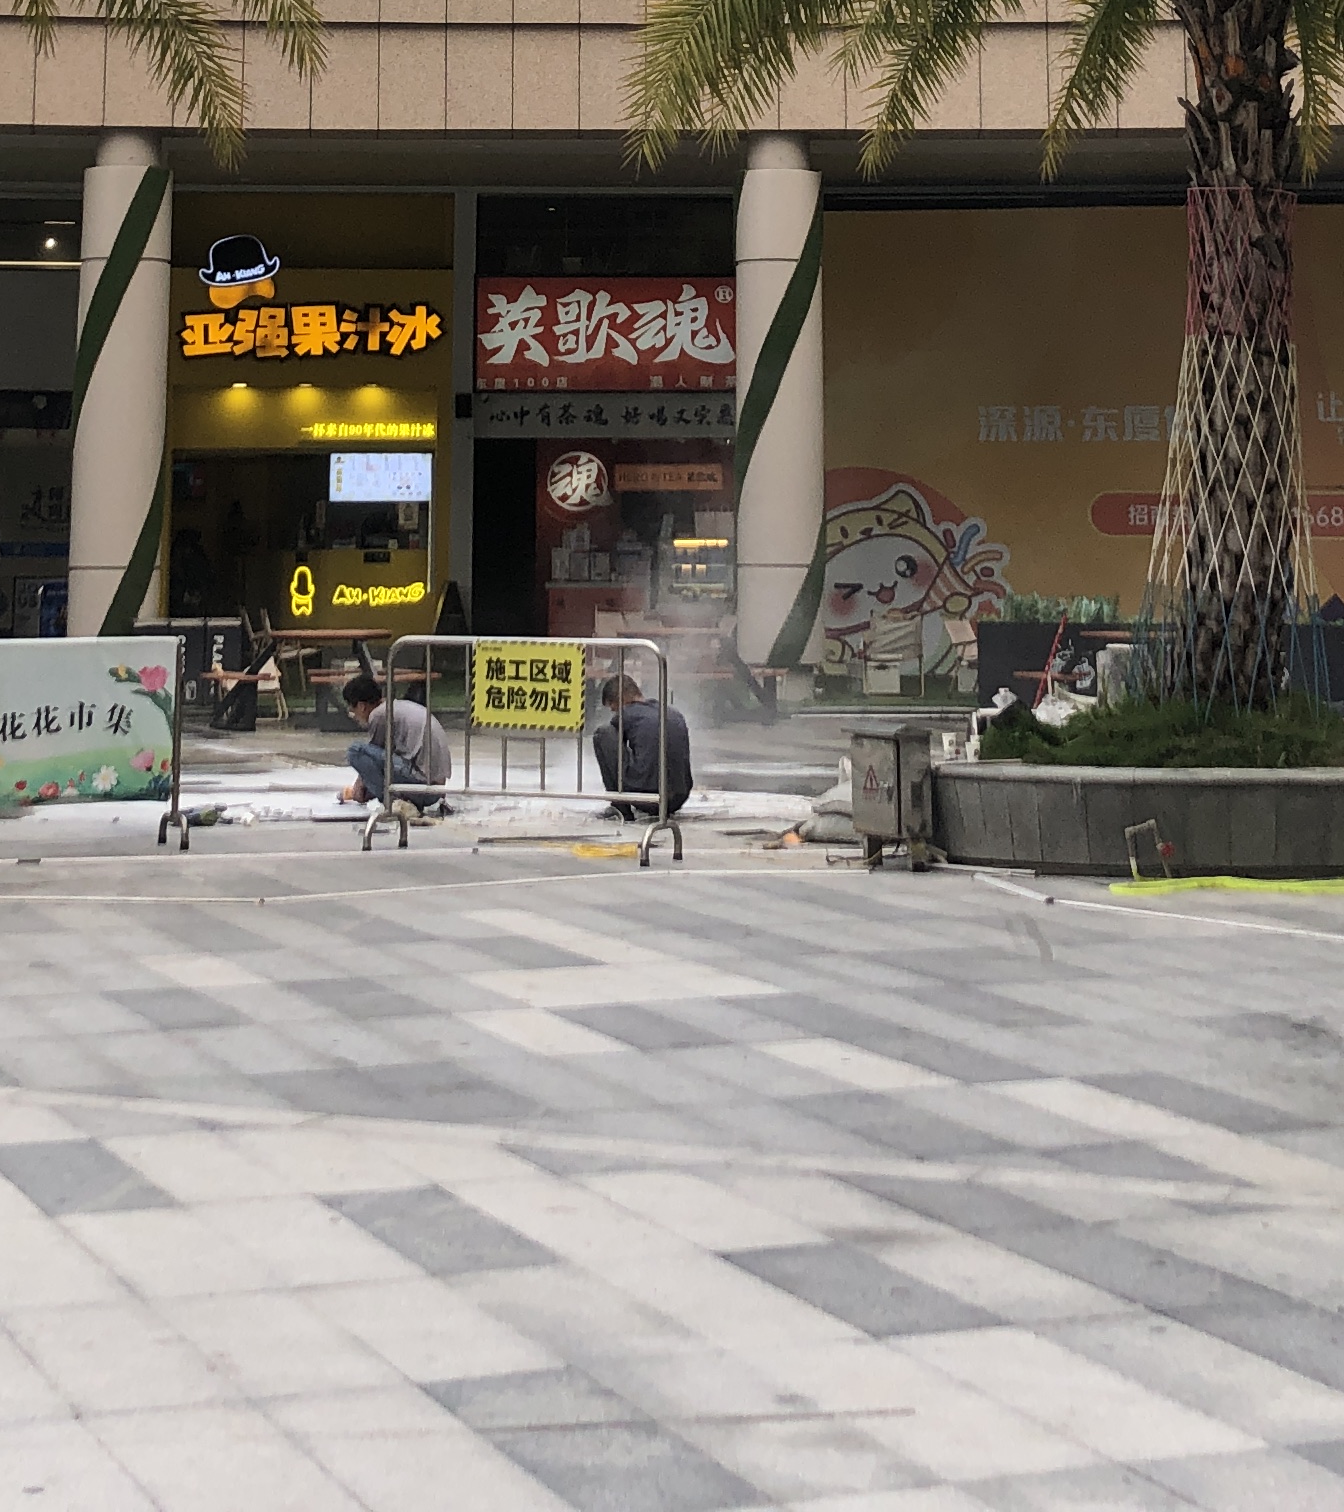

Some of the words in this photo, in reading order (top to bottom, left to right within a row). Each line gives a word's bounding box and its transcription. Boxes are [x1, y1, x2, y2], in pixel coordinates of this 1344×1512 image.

[181, 305, 443, 358] 亚强果汁冰
[478, 284, 736, 367] 英歌魂
[485, 656, 572, 684] 施工区域
[485, 685, 572, 713] 危险勿近
